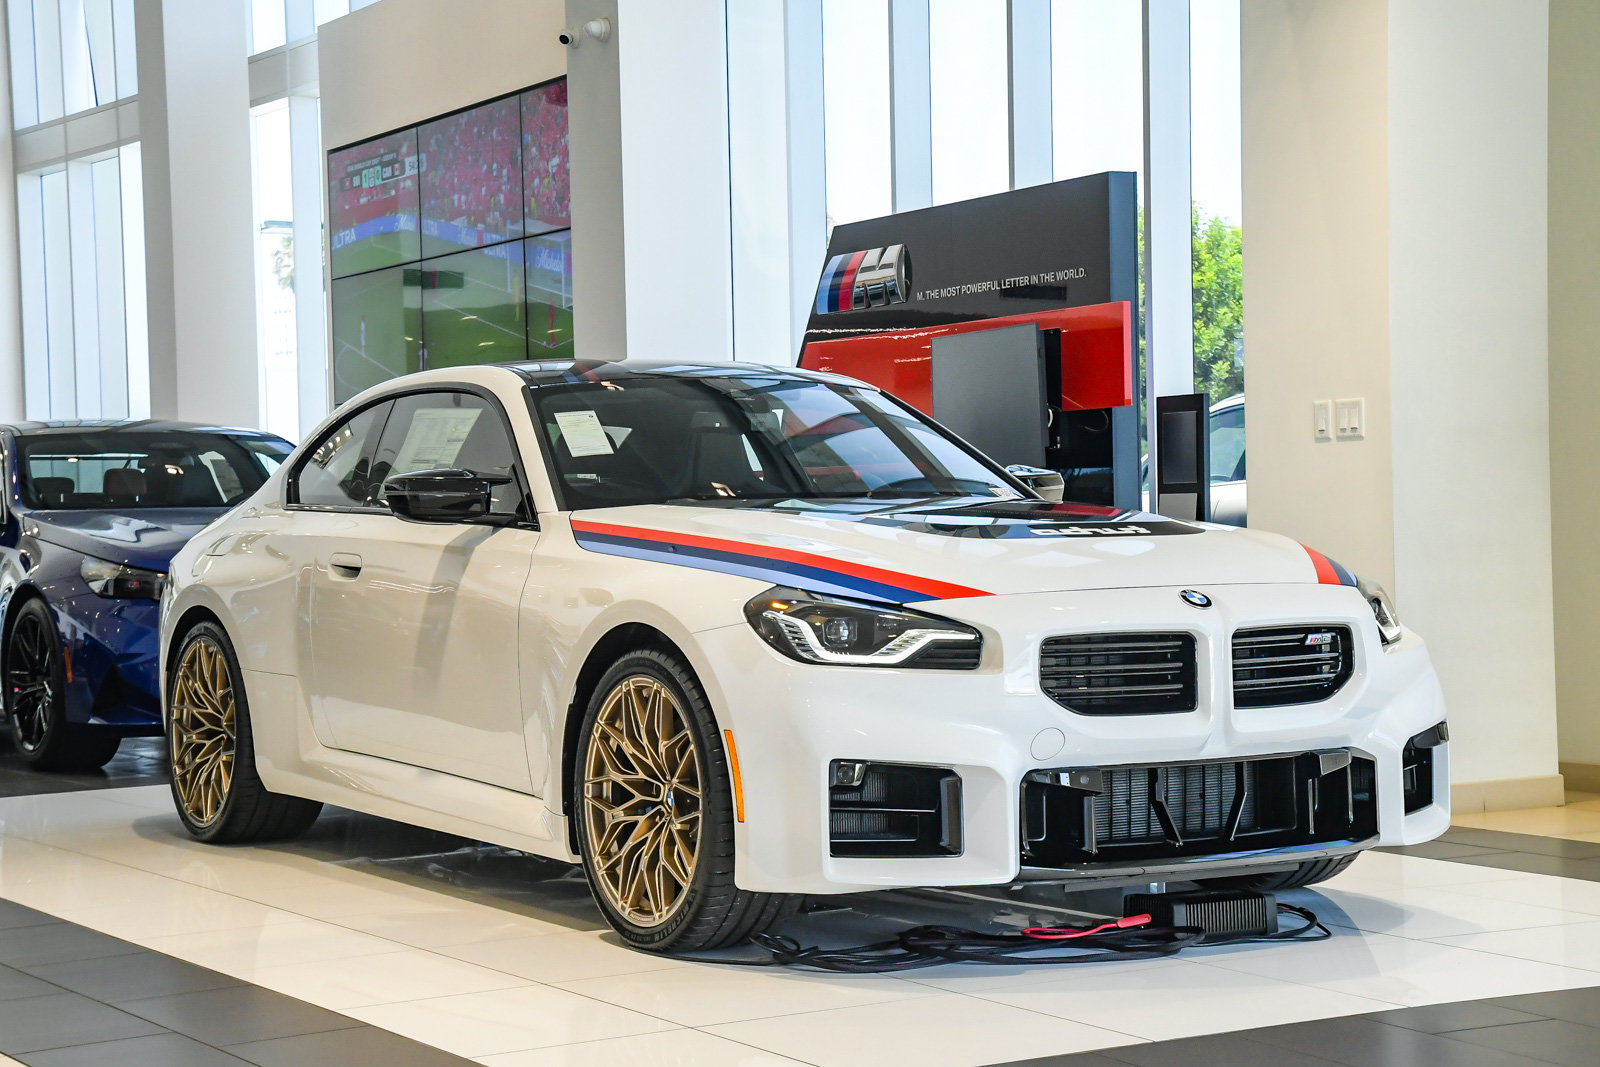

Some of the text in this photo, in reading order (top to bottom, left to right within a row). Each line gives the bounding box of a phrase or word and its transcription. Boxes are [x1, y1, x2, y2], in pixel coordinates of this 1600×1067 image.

[926, 289, 940, 300] THE
[940, 286, 960, 298] MOST
[961, 280, 1001, 295] POWERFUL
[1001, 275, 1030, 289] LETTER
[1030, 273, 1039, 285] IN
[1040, 271, 1055, 283] THE
[1056, 267, 1087, 281] WORLD.
[654, 903, 690, 942] MICHELIN
